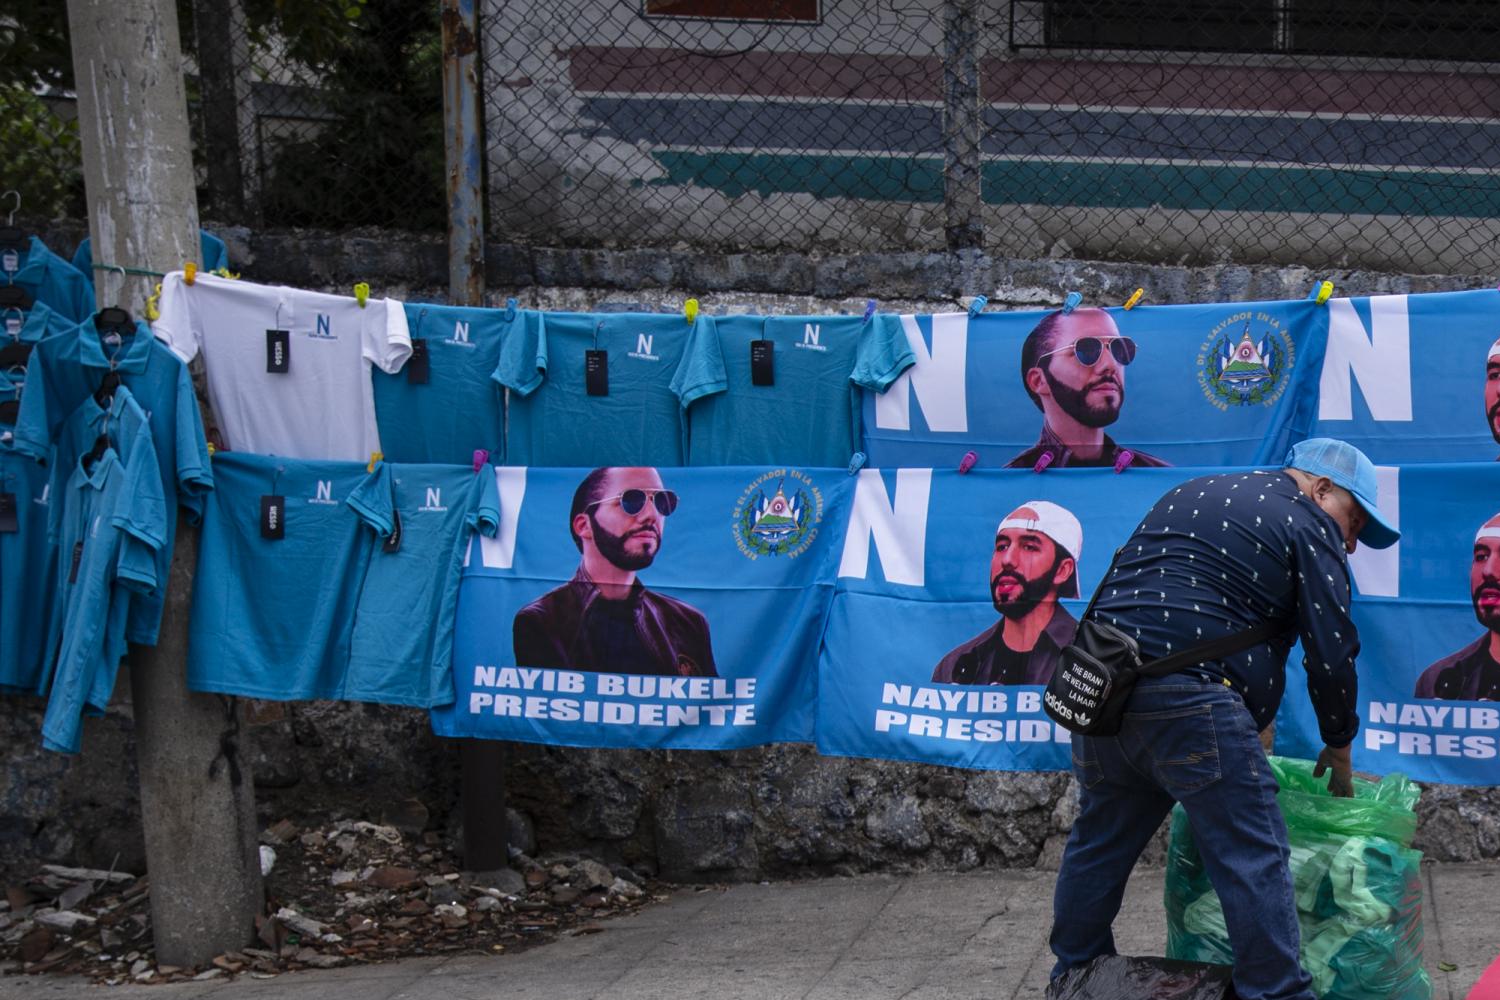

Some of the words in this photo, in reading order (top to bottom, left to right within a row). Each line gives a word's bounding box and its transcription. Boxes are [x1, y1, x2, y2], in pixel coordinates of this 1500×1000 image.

[317, 312, 330, 335] N
[454, 320, 469, 342] N
[804, 322, 820, 345] N
[637, 332, 653, 355] N
[1319, 295, 1413, 421] N
[875, 312, 968, 432] N
[317, 480, 331, 500] N
[426, 487, 441, 507] N
[837, 468, 933, 587] N
[1062, 670, 1071, 682] DIE
[1072, 663, 1083, 675] THE
[473, 665, 585, 694] NAYIB
[597, 674, 757, 700] BUKELE
[882, 682, 1008, 713] NAYIB
[1044, 691, 1073, 720] adidas
[1068, 690, 1077, 702] LA
[469, 692, 757, 727] PRESIDENTE
[1369, 701, 1500, 730] NAYIB
